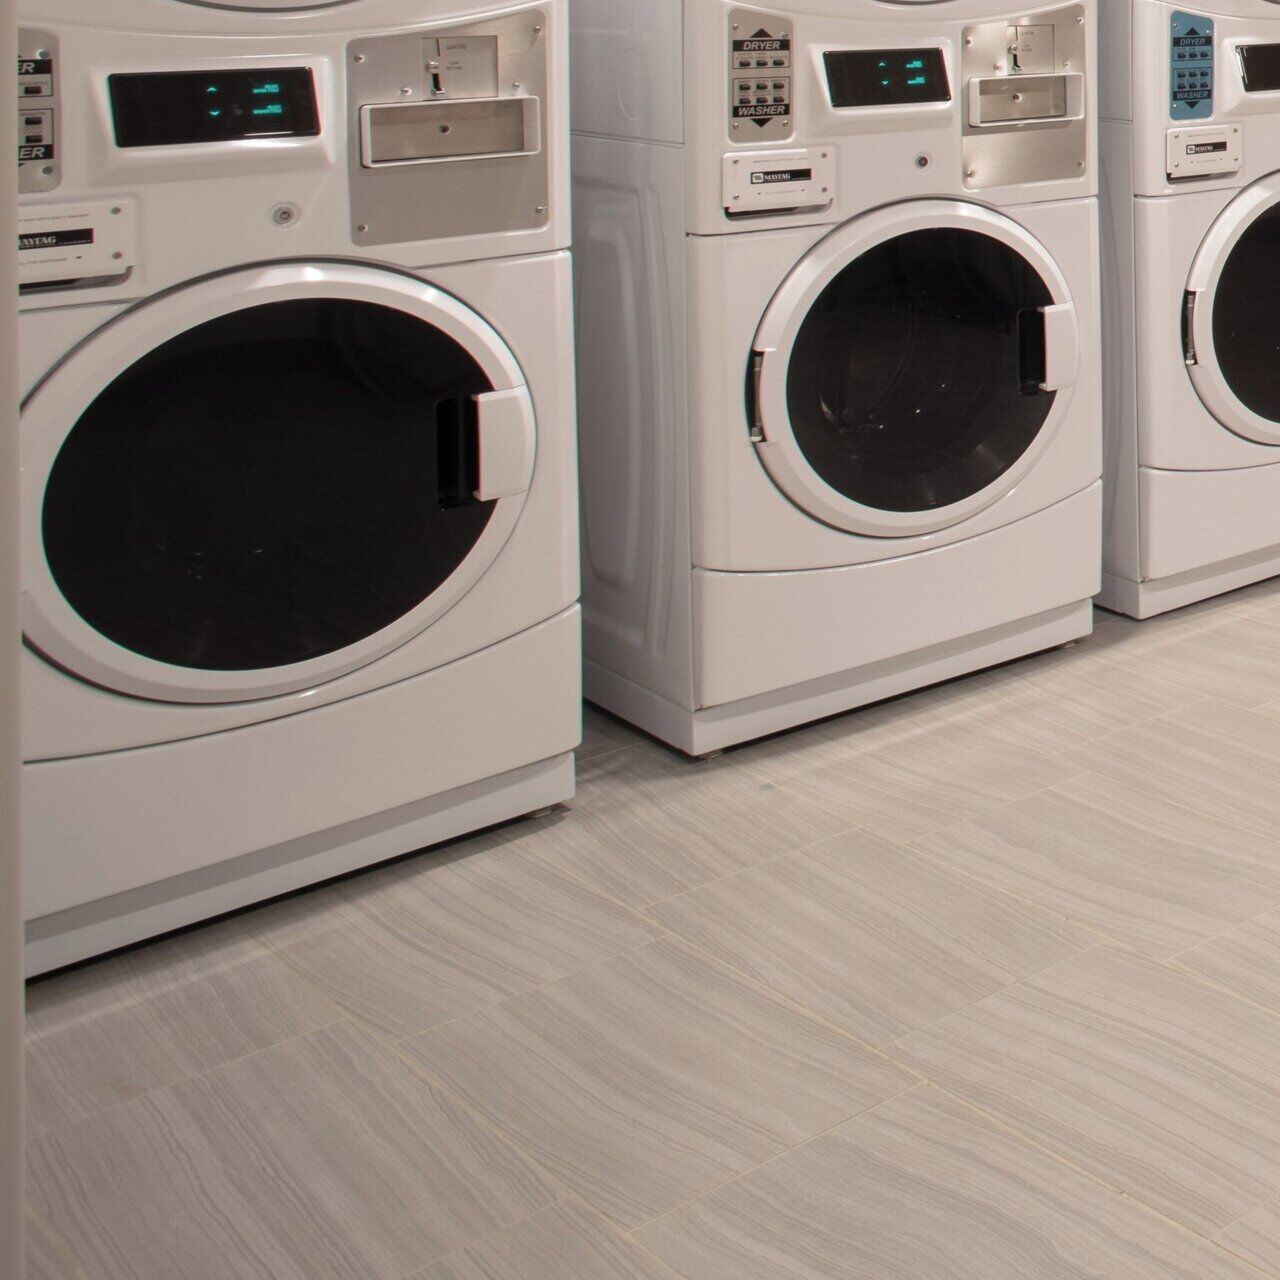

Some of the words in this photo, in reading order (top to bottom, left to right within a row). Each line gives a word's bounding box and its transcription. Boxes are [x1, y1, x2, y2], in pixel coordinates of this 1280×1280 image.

[743, 41, 781, 51] DRYER
[1180, 38, 1206, 46] DRYER
[1176, 90, 1208, 99] WASHER
[738, 105, 786, 116] WASHER
[764, 173, 791, 181] MAYTAG
